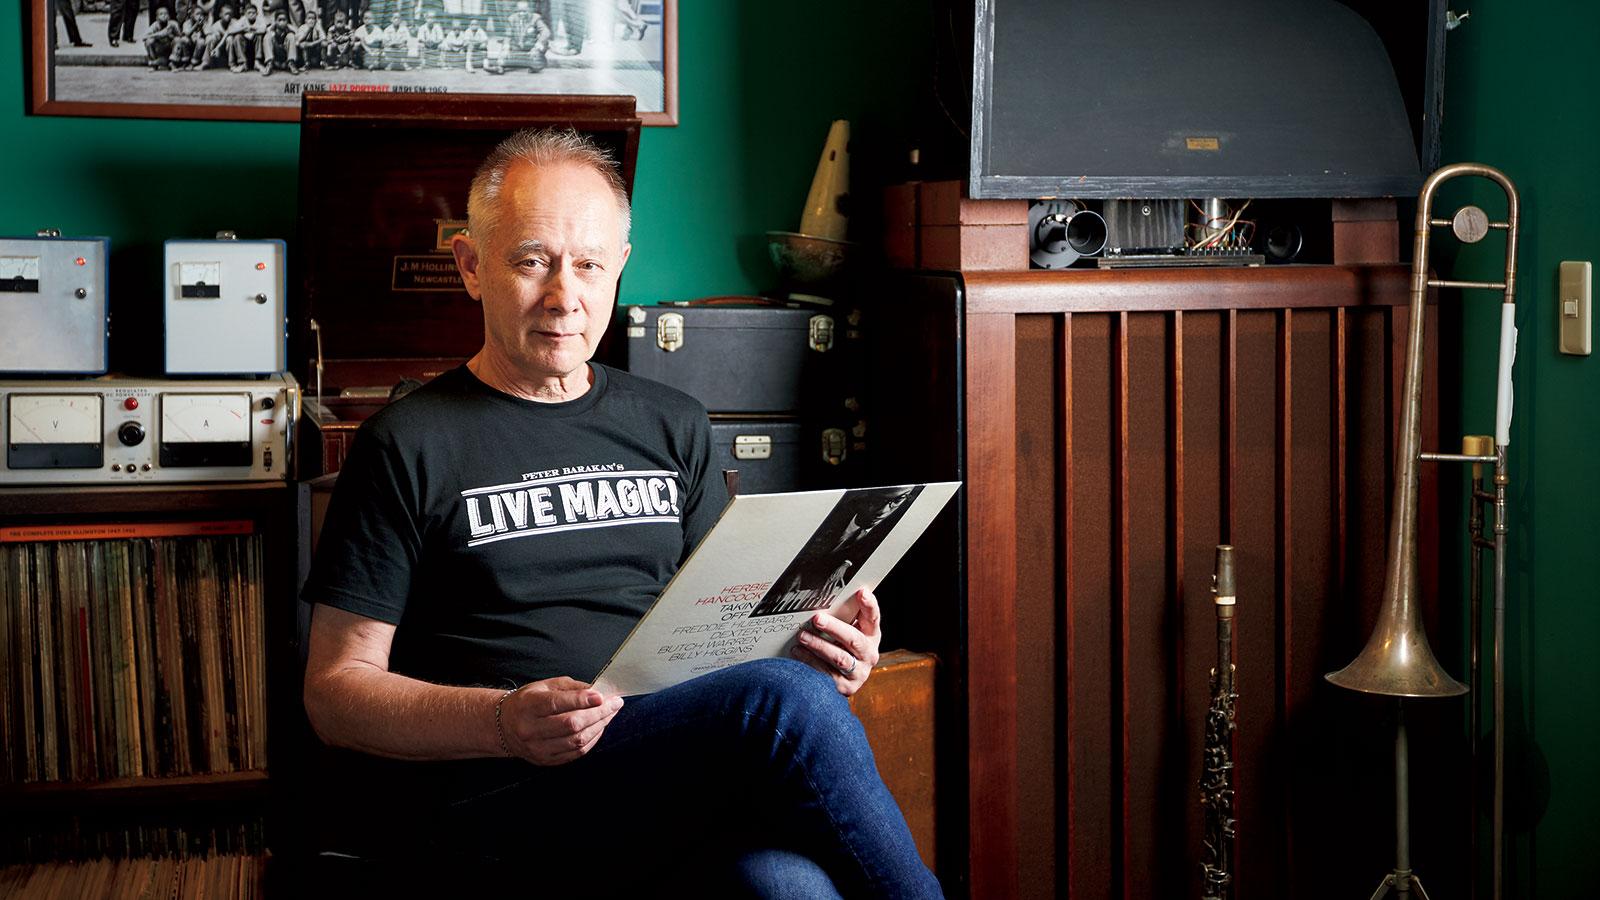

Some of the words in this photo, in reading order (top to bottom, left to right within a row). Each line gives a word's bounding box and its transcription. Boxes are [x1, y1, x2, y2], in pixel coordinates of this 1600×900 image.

[284, 83, 300, 94] ART
[303, 84, 326, 92] KANE
[53, 420, 59, 429] V
[203, 419, 210, 428] A
[521, 469, 560, 481] PETER
[562, 462, 625, 475] BARAKAN'S
[465, 486, 558, 538] LIVE
[558, 477, 680, 523] MAGIC!
[721, 582, 772, 594] HERBIE
[695, 591, 766, 606] HANCOCK
[721, 610, 750, 621] OFF
[672, 621, 729, 635] FREDDIE
[731, 614, 794, 629] HUBBARD
[710, 626, 762, 640] DEXTER
[657, 642, 705, 655] BUTCH
[706, 635, 762, 649] WARREN
[668, 650, 703, 662] BILLY
[703, 644, 755, 657] HIGGINS
